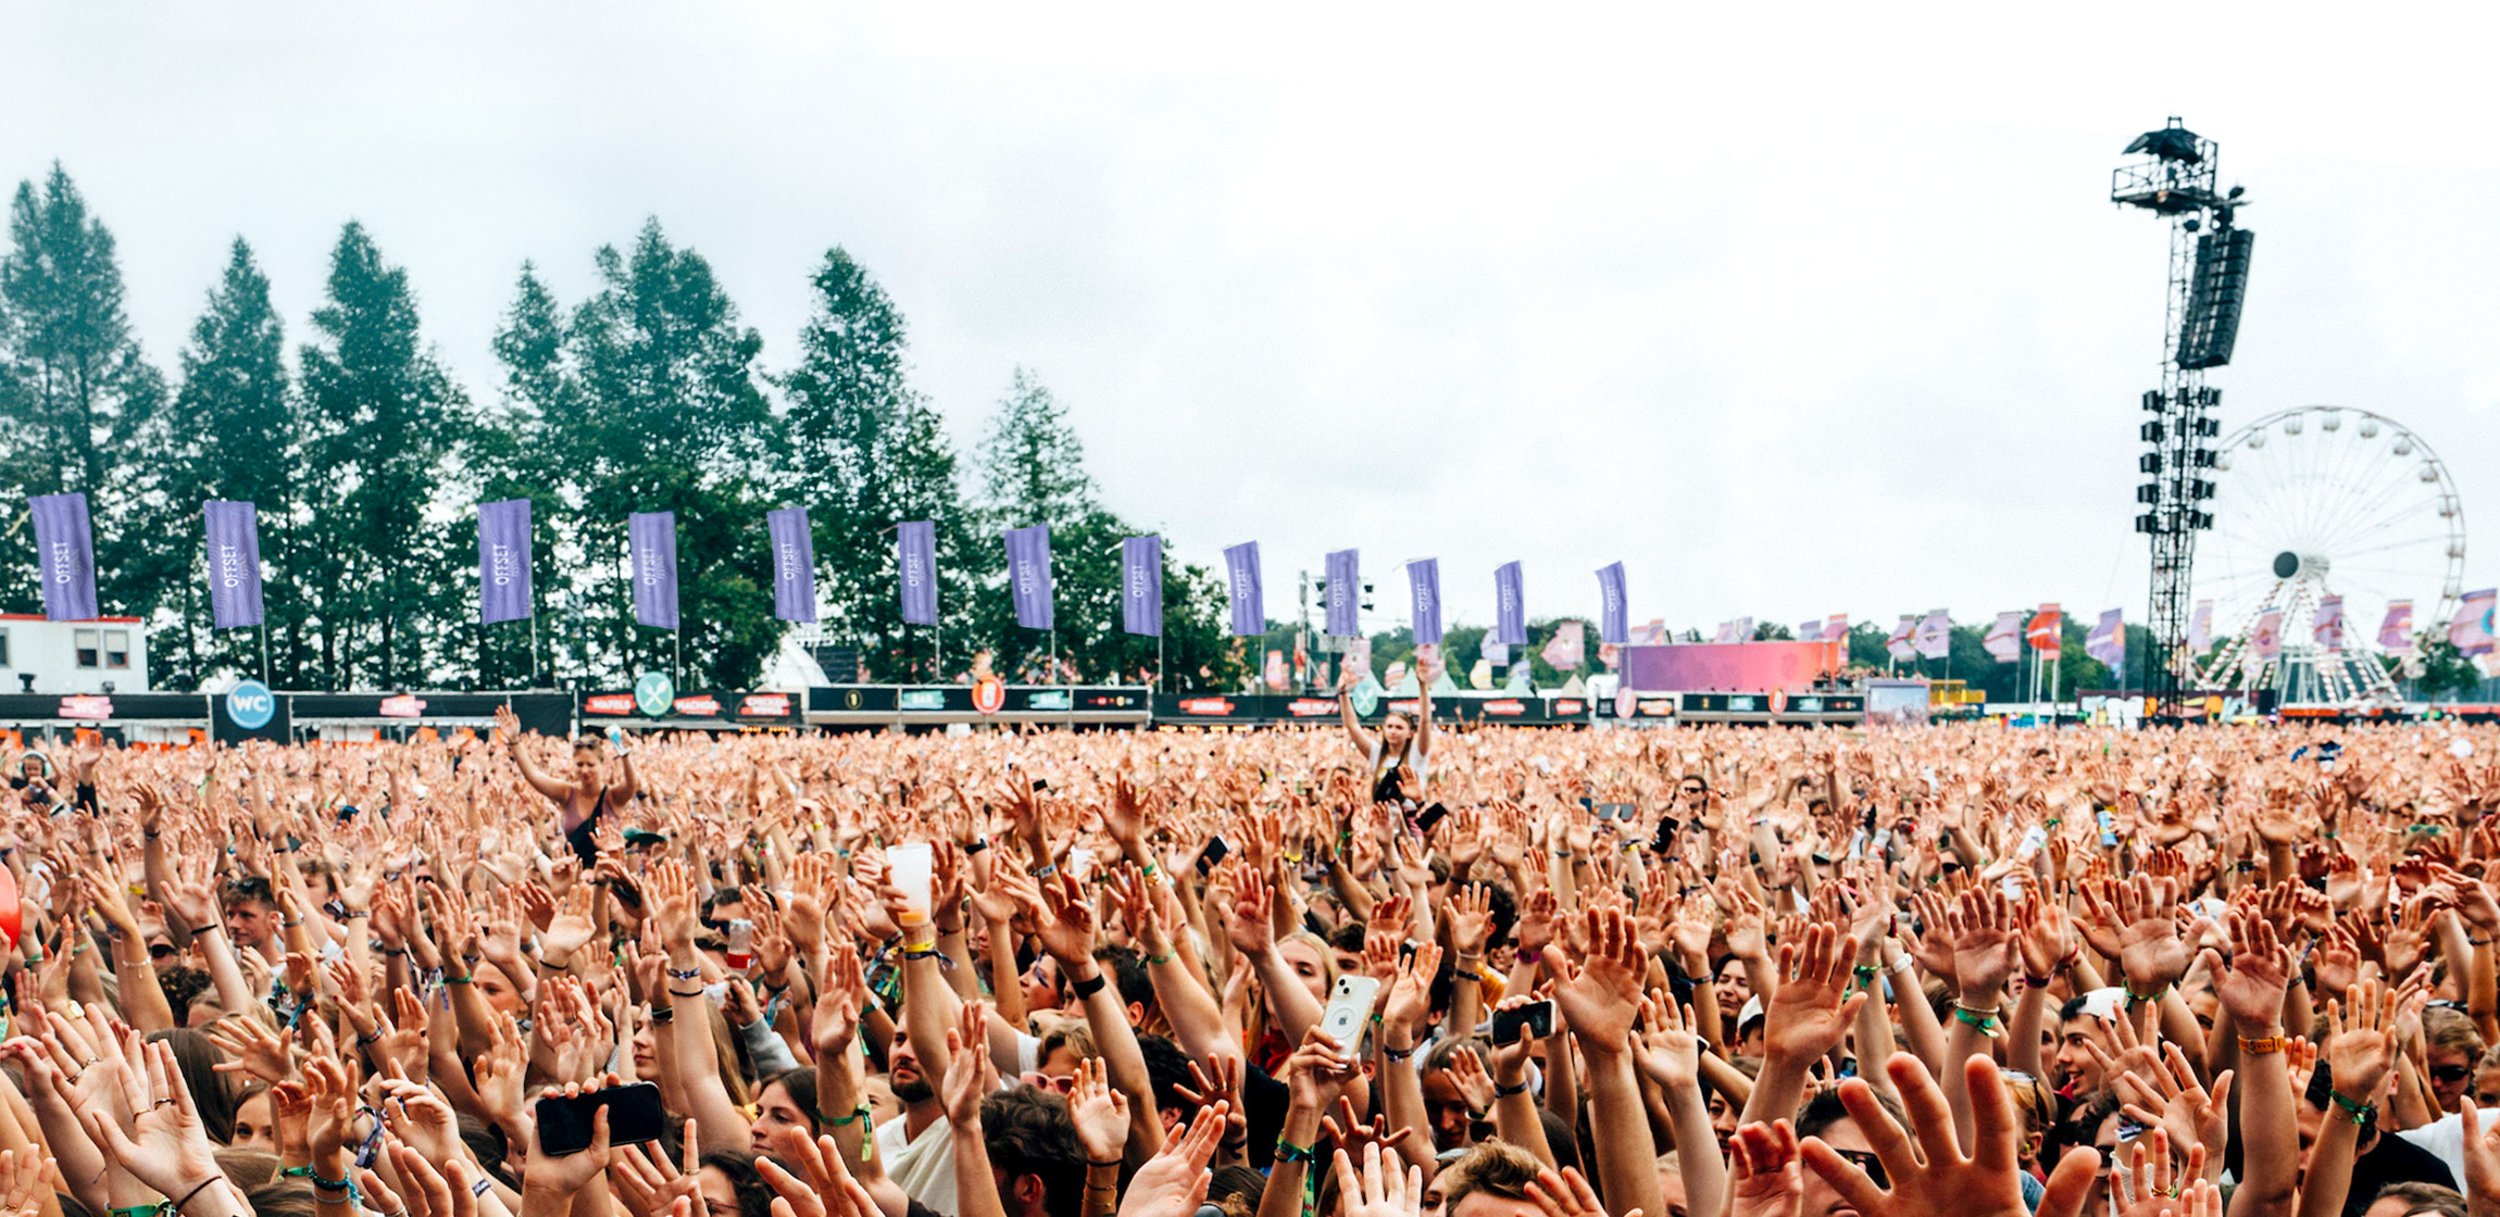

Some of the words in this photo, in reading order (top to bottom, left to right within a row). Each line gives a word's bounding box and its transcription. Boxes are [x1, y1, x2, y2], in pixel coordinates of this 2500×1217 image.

[53, 542, 70, 584] OFFSET
[221, 543, 239, 588] OFFSET
[493, 544, 509, 586] OFFSET
[641, 547, 656, 586] OFFSET
[781, 543, 796, 581] OFFSET
[908, 552, 919, 587] OFFSET
[1018, 560, 1031, 595] OFFSET
[1132, 565, 1144, 598] OFFSET
[1235, 568, 1248, 600] OFFSET
[1332, 579, 1344, 608] OFFSET
[1417, 583, 1427, 612] OFFSET
[73, 701, 99, 715] WC
[232, 695, 268, 713] WC
[850, 693, 857, 706] 1
